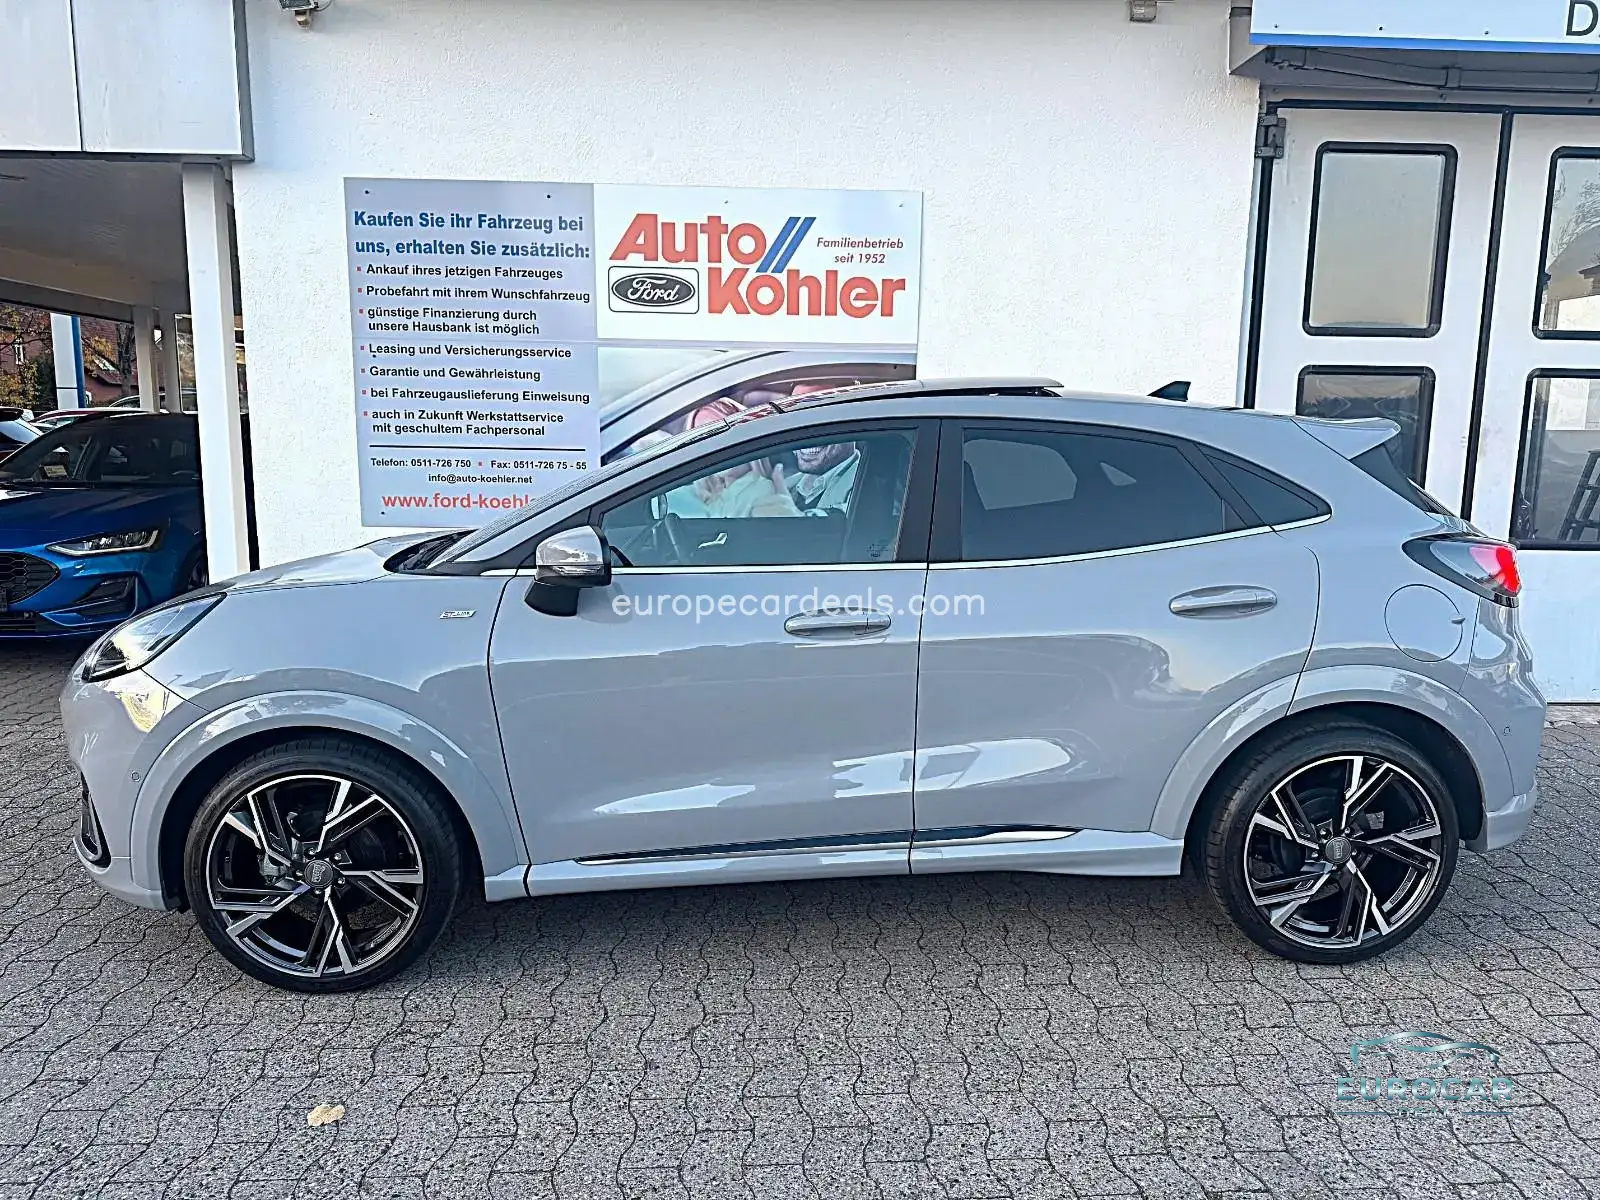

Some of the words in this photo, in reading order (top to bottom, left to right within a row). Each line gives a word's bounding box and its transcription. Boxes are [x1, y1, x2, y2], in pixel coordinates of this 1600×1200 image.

[354, 211, 413, 226] Kaufen
[419, 213, 444, 228] Sie
[450, 214, 472, 228] ihr
[478, 214, 552, 233] Fahrzeug
[559, 216, 583, 230] bei
[609, 213, 766, 264] Auto
[817, 237, 903, 249] Familienbetrieb
[355, 242, 390, 256] uns,
[396, 240, 465, 254] erhalten
[471, 241, 496, 255] Sie
[502, 243, 590, 258] zusätzlich:
[834, 253, 854, 263] seit
[857, 253, 885, 264] 1952
[367, 264, 409, 275] Ankauf
[412, 266, 441, 275] ihres
[445, 266, 491, 278] jetzigen
[495, 267, 563, 280] Fahrzeuges
[367, 286, 429, 297] Probefahrt
[433, 288, 450, 297] mit
[455, 288, 487, 298] ihrem
[492, 289, 590, 303] Wunschfahrzeug
[627, 277, 680, 301] Ford
[368, 307, 419, 320] günstige
[423, 308, 499, 321] Finanzierung
[503, 310, 537, 320] durch
[368, 322, 409, 331] unsere
[412, 322, 471, 333] Hausbank
[475, 323, 489, 333] ist
[493, 324, 539, 337] möglich
[369, 344, 415, 357] Leasing
[419, 345, 441, 355] und
[445, 345, 571, 358] Versicherungsservice
[369, 366, 420, 377] Garantie
[423, 368, 445, 377] und
[449, 368, 540, 381] Gewährleistung
[371, 388, 388, 398] bei
[392, 389, 519, 402] Fahrzeugauslieferung
[523, 392, 590, 404] Einweisung
[372, 410, 400, 419] auch
[404, 410, 415, 420] in
[418, 410, 463, 421] Zukunft
[466, 412, 563, 422] Werkstattservice
[373, 423, 391, 433] mit
[395, 424, 462, 437] geschultem
[466, 425, 544, 437] Fachpersonal
[371, 458, 408, 467] Telefon:
[411, 459, 452, 467] 0511-726
[455, 460, 471, 468] 750
[491, 460, 511, 469] Fax:
[514, 461, 554, 469] 0511-726
[556, 461, 568, 469] 75
[576, 462, 587, 470] 55
[428, 474, 532, 484] info@auto-koehler.net
[382, 493, 537, 509] www.ford-koehl
